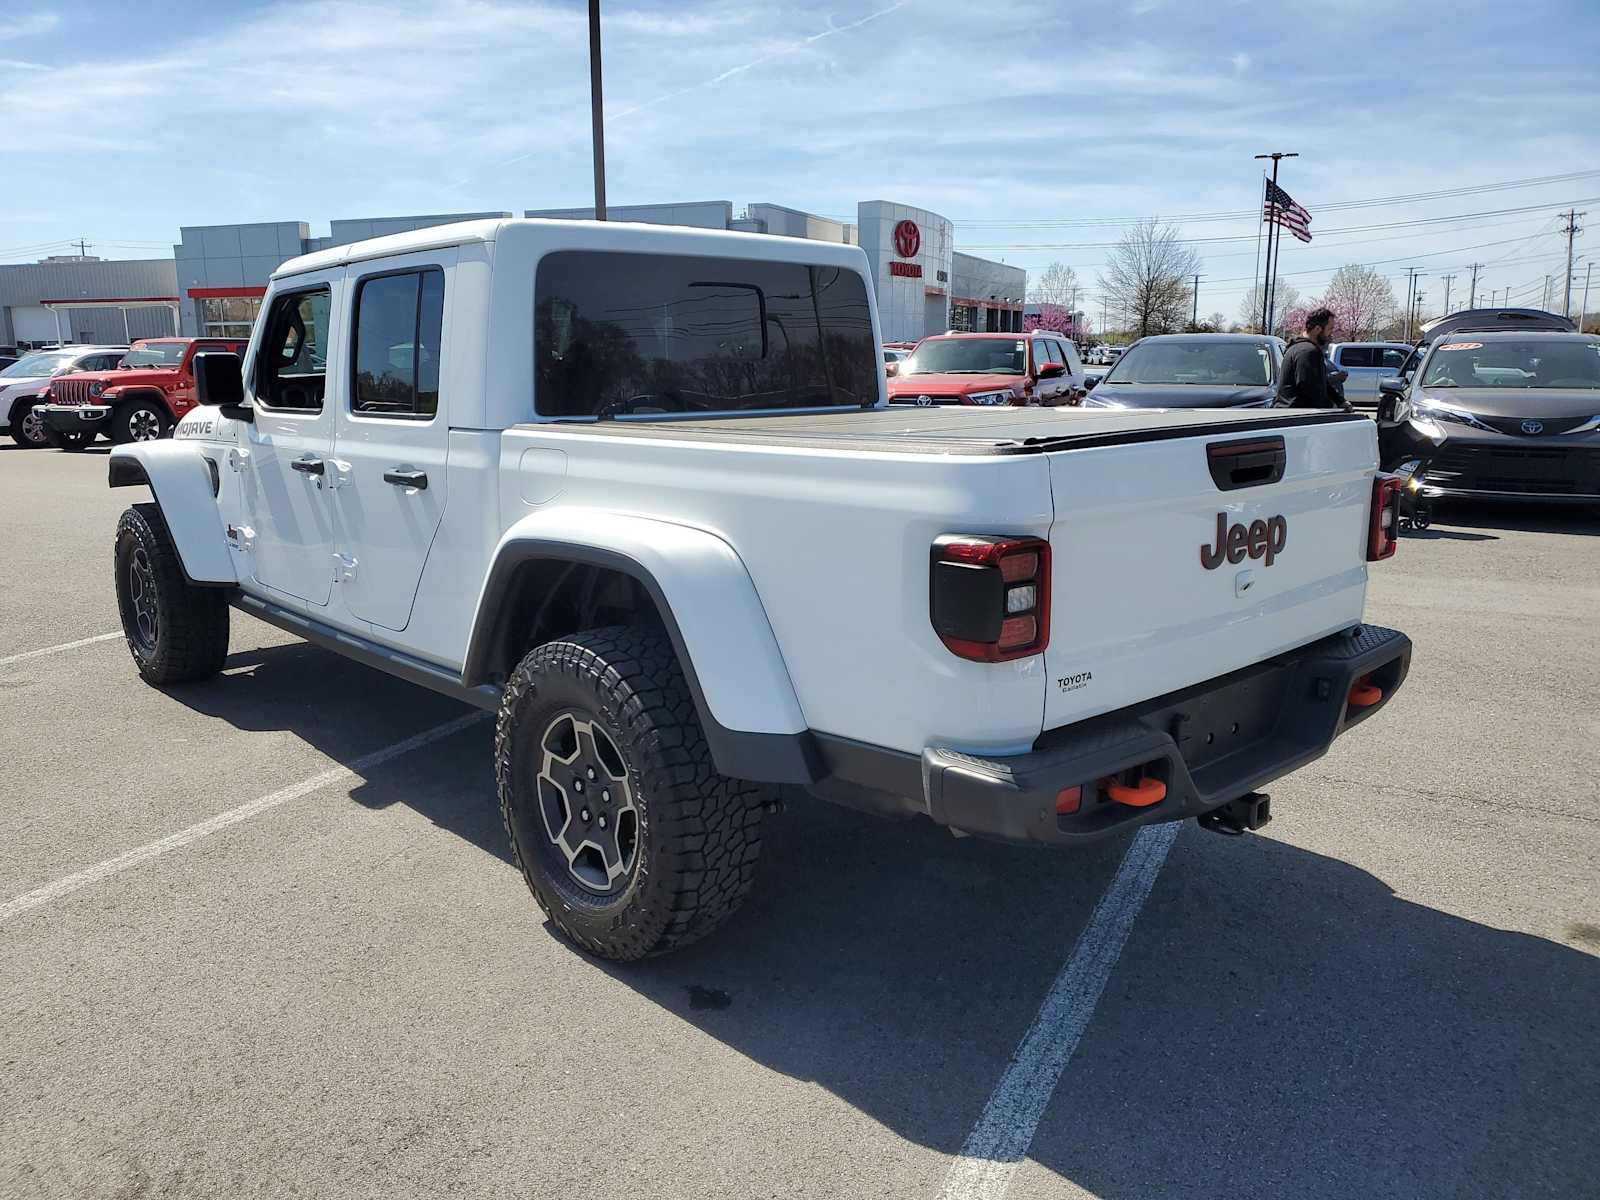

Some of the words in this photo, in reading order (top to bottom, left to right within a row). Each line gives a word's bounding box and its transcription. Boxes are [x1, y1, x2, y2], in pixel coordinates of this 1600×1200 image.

[892, 263, 922, 277] TOYOTA
[1200, 512, 1287, 570] Jeep
[1057, 672, 1092, 687] TOYOTA
